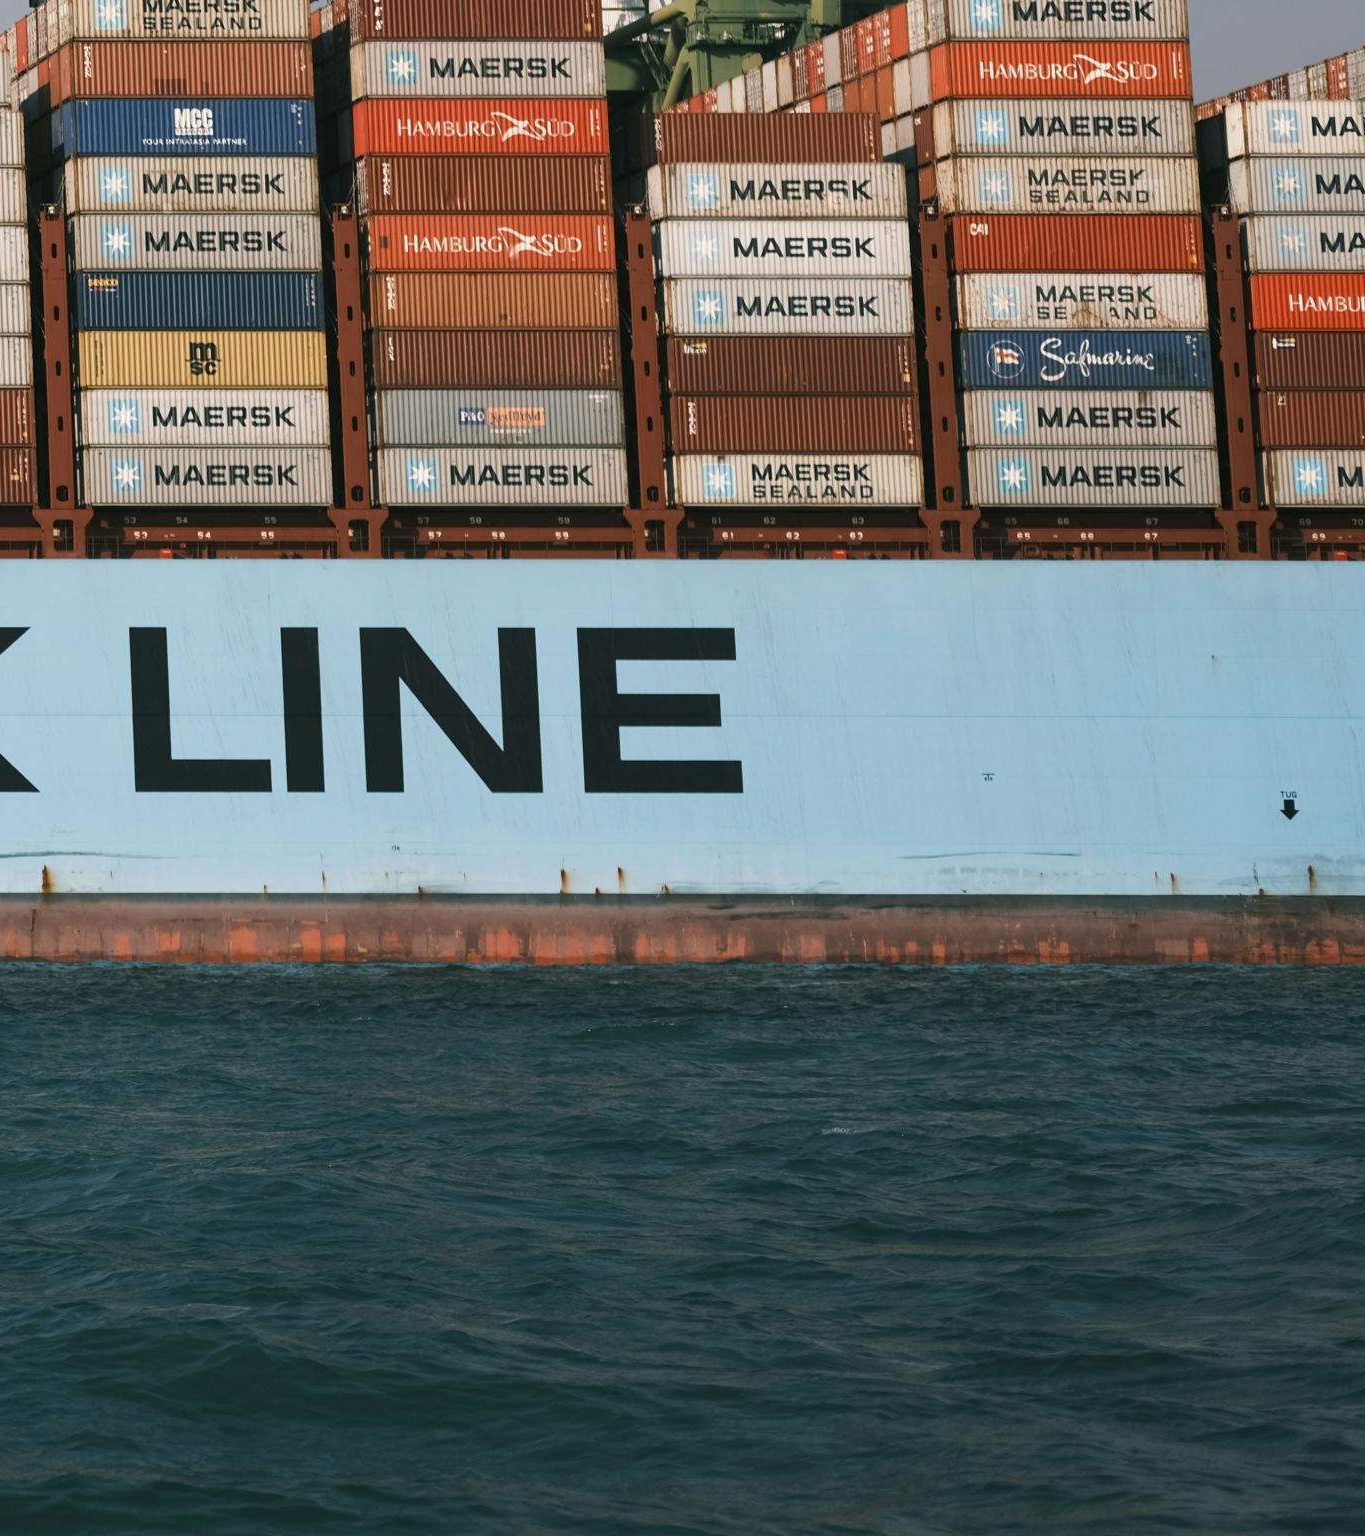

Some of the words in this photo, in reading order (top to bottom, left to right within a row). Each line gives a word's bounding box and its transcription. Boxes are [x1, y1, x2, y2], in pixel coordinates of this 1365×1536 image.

[1013, 1, 1155, 22] MAERSK
[143, 16, 261, 30] SEALAND
[430, 57, 571, 78] MAERSK
[980, 61, 1077, 80] HAMBURG
[1117, 60, 1157, 80] SÜD
[174, 108, 213, 128] MCC
[397, 119, 495, 137] HAMBURG
[535, 118, 574, 137] SÜD
[1019, 116, 1162, 137] MAERSK
[143, 173, 285, 194] MAERSK
[1029, 169, 1146, 186] MAERSK
[731, 180, 872, 201] MAERSK
[1029, 190, 1149, 204] SEALAND
[970, 224, 988, 235] CAI
[145, 231, 287, 252] MAERSK
[404, 235, 502, 253] HAMBURG
[542, 234, 581, 253] SÜD
[733, 237, 876, 258] MAERSK
[1036, 286, 1156, 302] MAERSK
[737, 296, 879, 317] MAERSK
[1039, 338, 1155, 380] Safmarine
[152, 406, 295, 427] MAERSK
[1037, 407, 1181, 428] MAERSK
[155, 465, 298, 486] MAERSK
[451, 465, 593, 486] MAERSK
[752, 464, 871, 481] MAERSK
[1041, 466, 1185, 487] MAERSK
[753, 485, 873, 499] SEALAND
[129, 627, 743, 793] LINE
[1280, 790, 1298, 798] TUG
